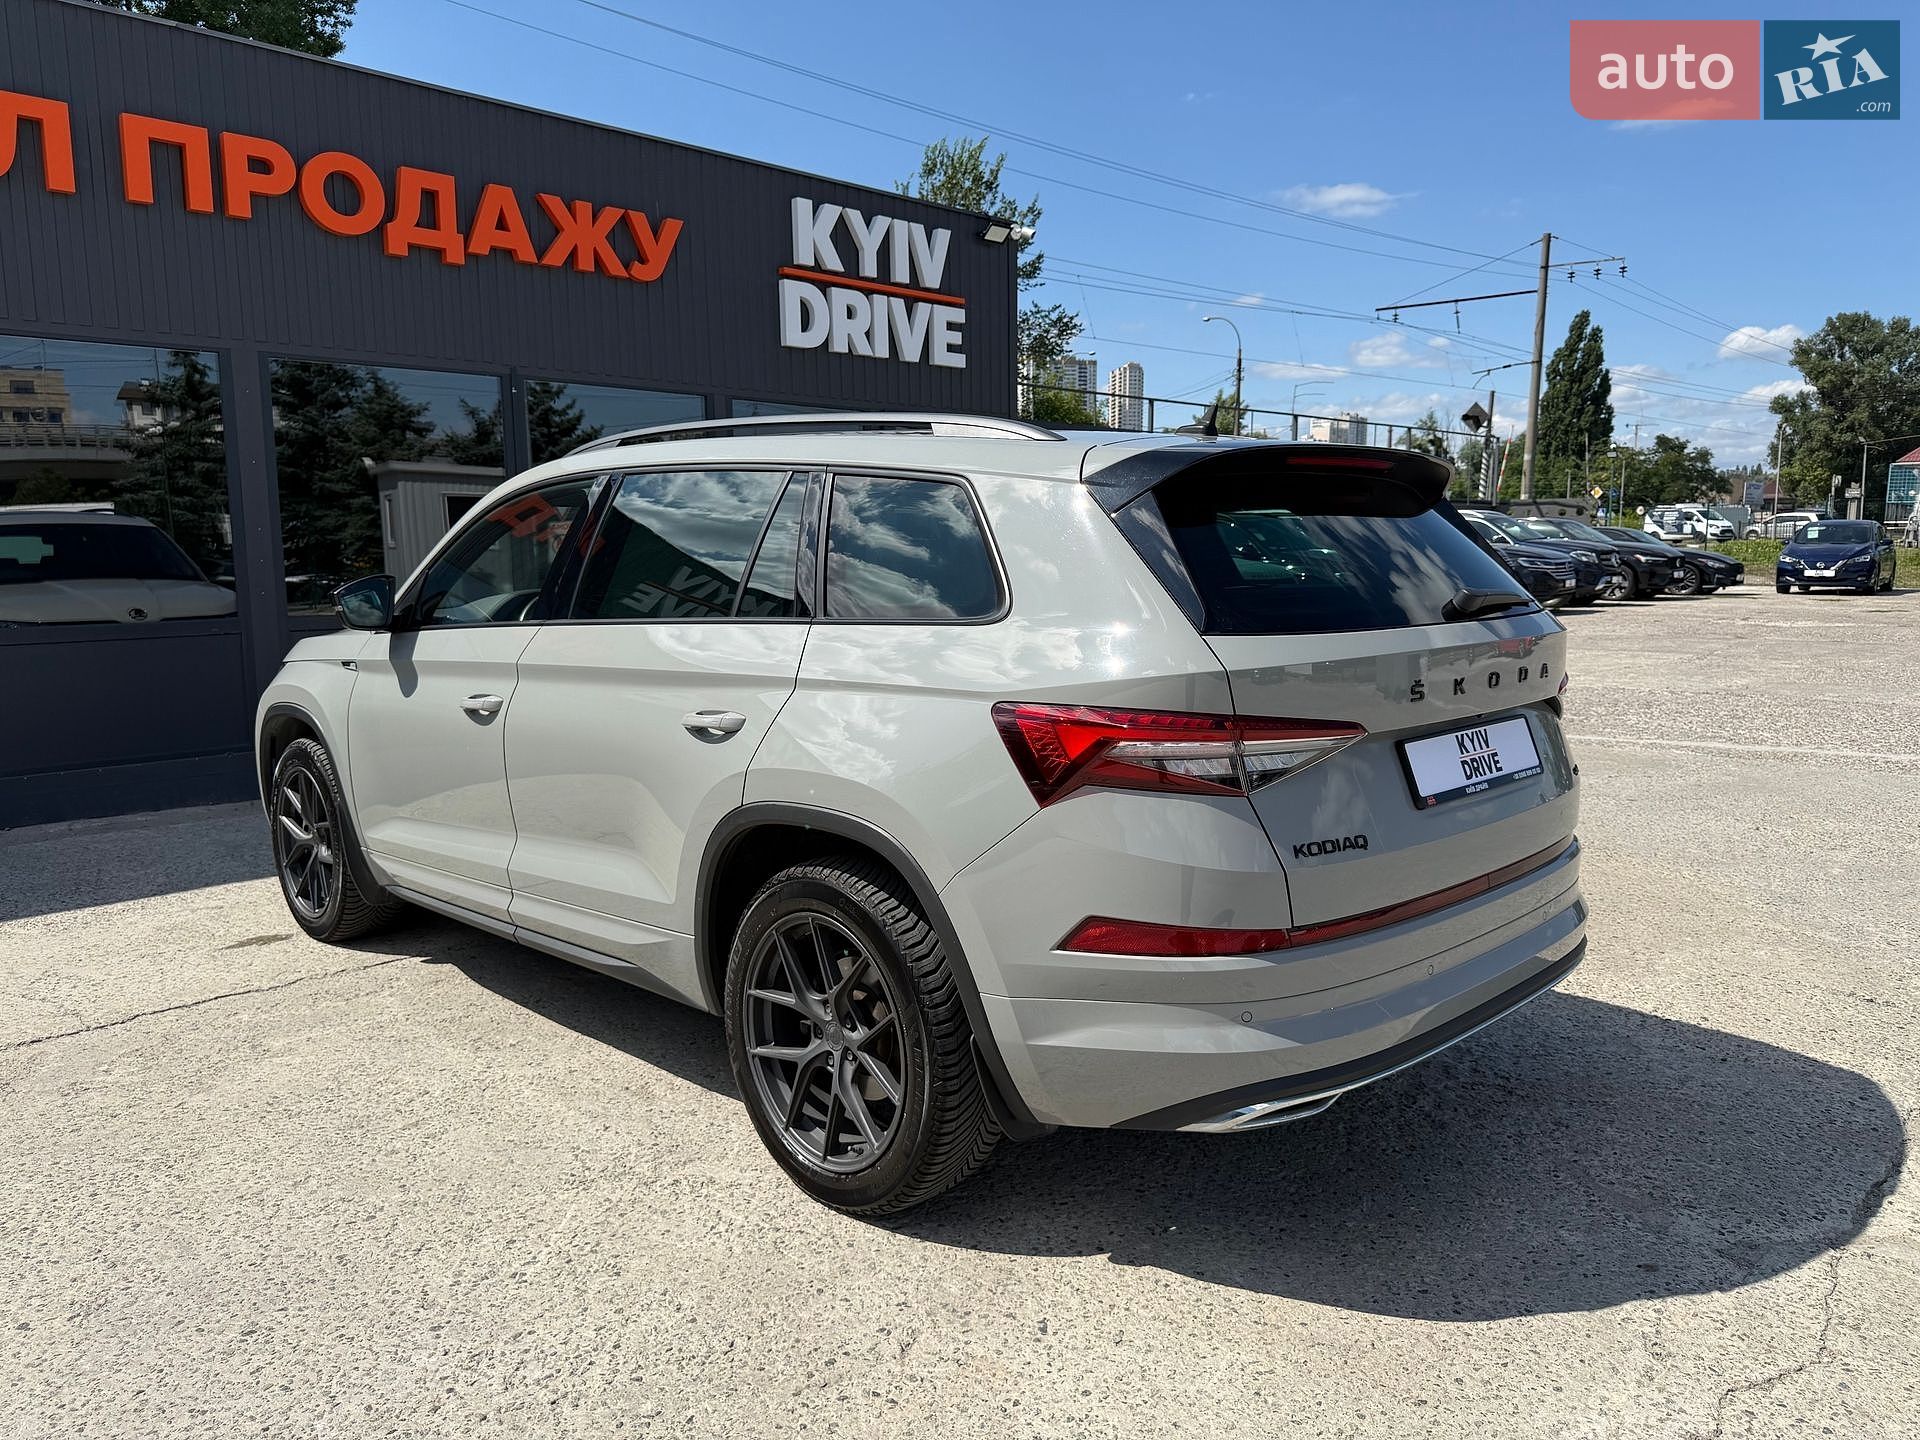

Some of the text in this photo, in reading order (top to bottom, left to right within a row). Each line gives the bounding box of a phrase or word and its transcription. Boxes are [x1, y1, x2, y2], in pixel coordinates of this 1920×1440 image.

[118, 112, 685, 283] ПРОДАЖУ
[791, 196, 952, 290] KYIV
[778, 278, 967, 369] DRIVE
[1410, 663, 1549, 702] ŠKODA
[1455, 729, 1490, 754] KYIV
[1460, 752, 1503, 780] DRIVE
[1293, 834, 1369, 859] KODIAQ
